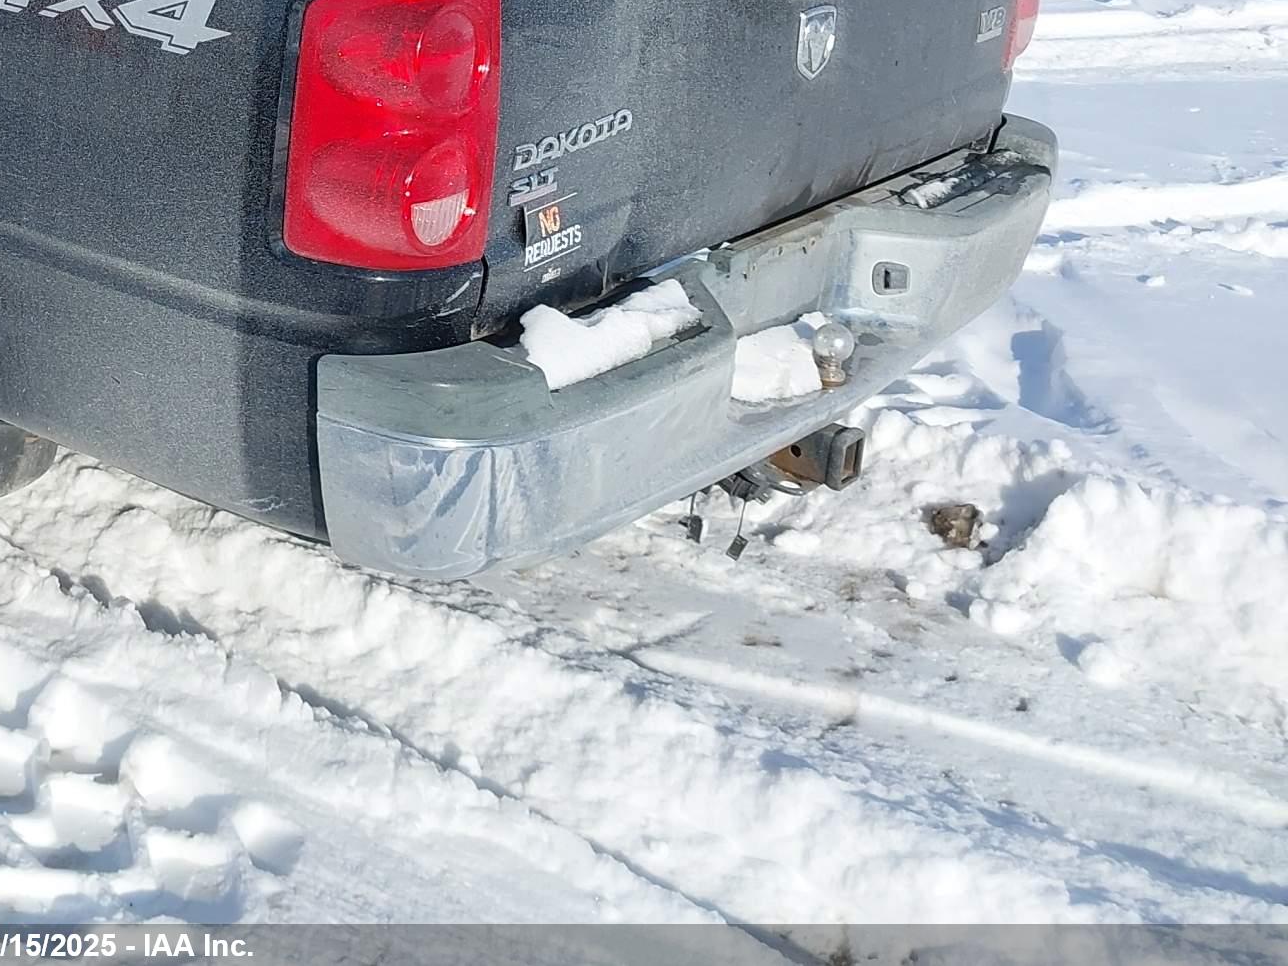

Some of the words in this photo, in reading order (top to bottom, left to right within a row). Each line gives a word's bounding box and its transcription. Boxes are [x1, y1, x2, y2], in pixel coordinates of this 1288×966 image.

[979, 6, 1007, 35] V8
[513, 108, 633, 171] DAKOTA
[510, 167, 559, 196] SLT
[538, 206, 561, 238] NO
[524, 224, 583, 267] REQUESTS
